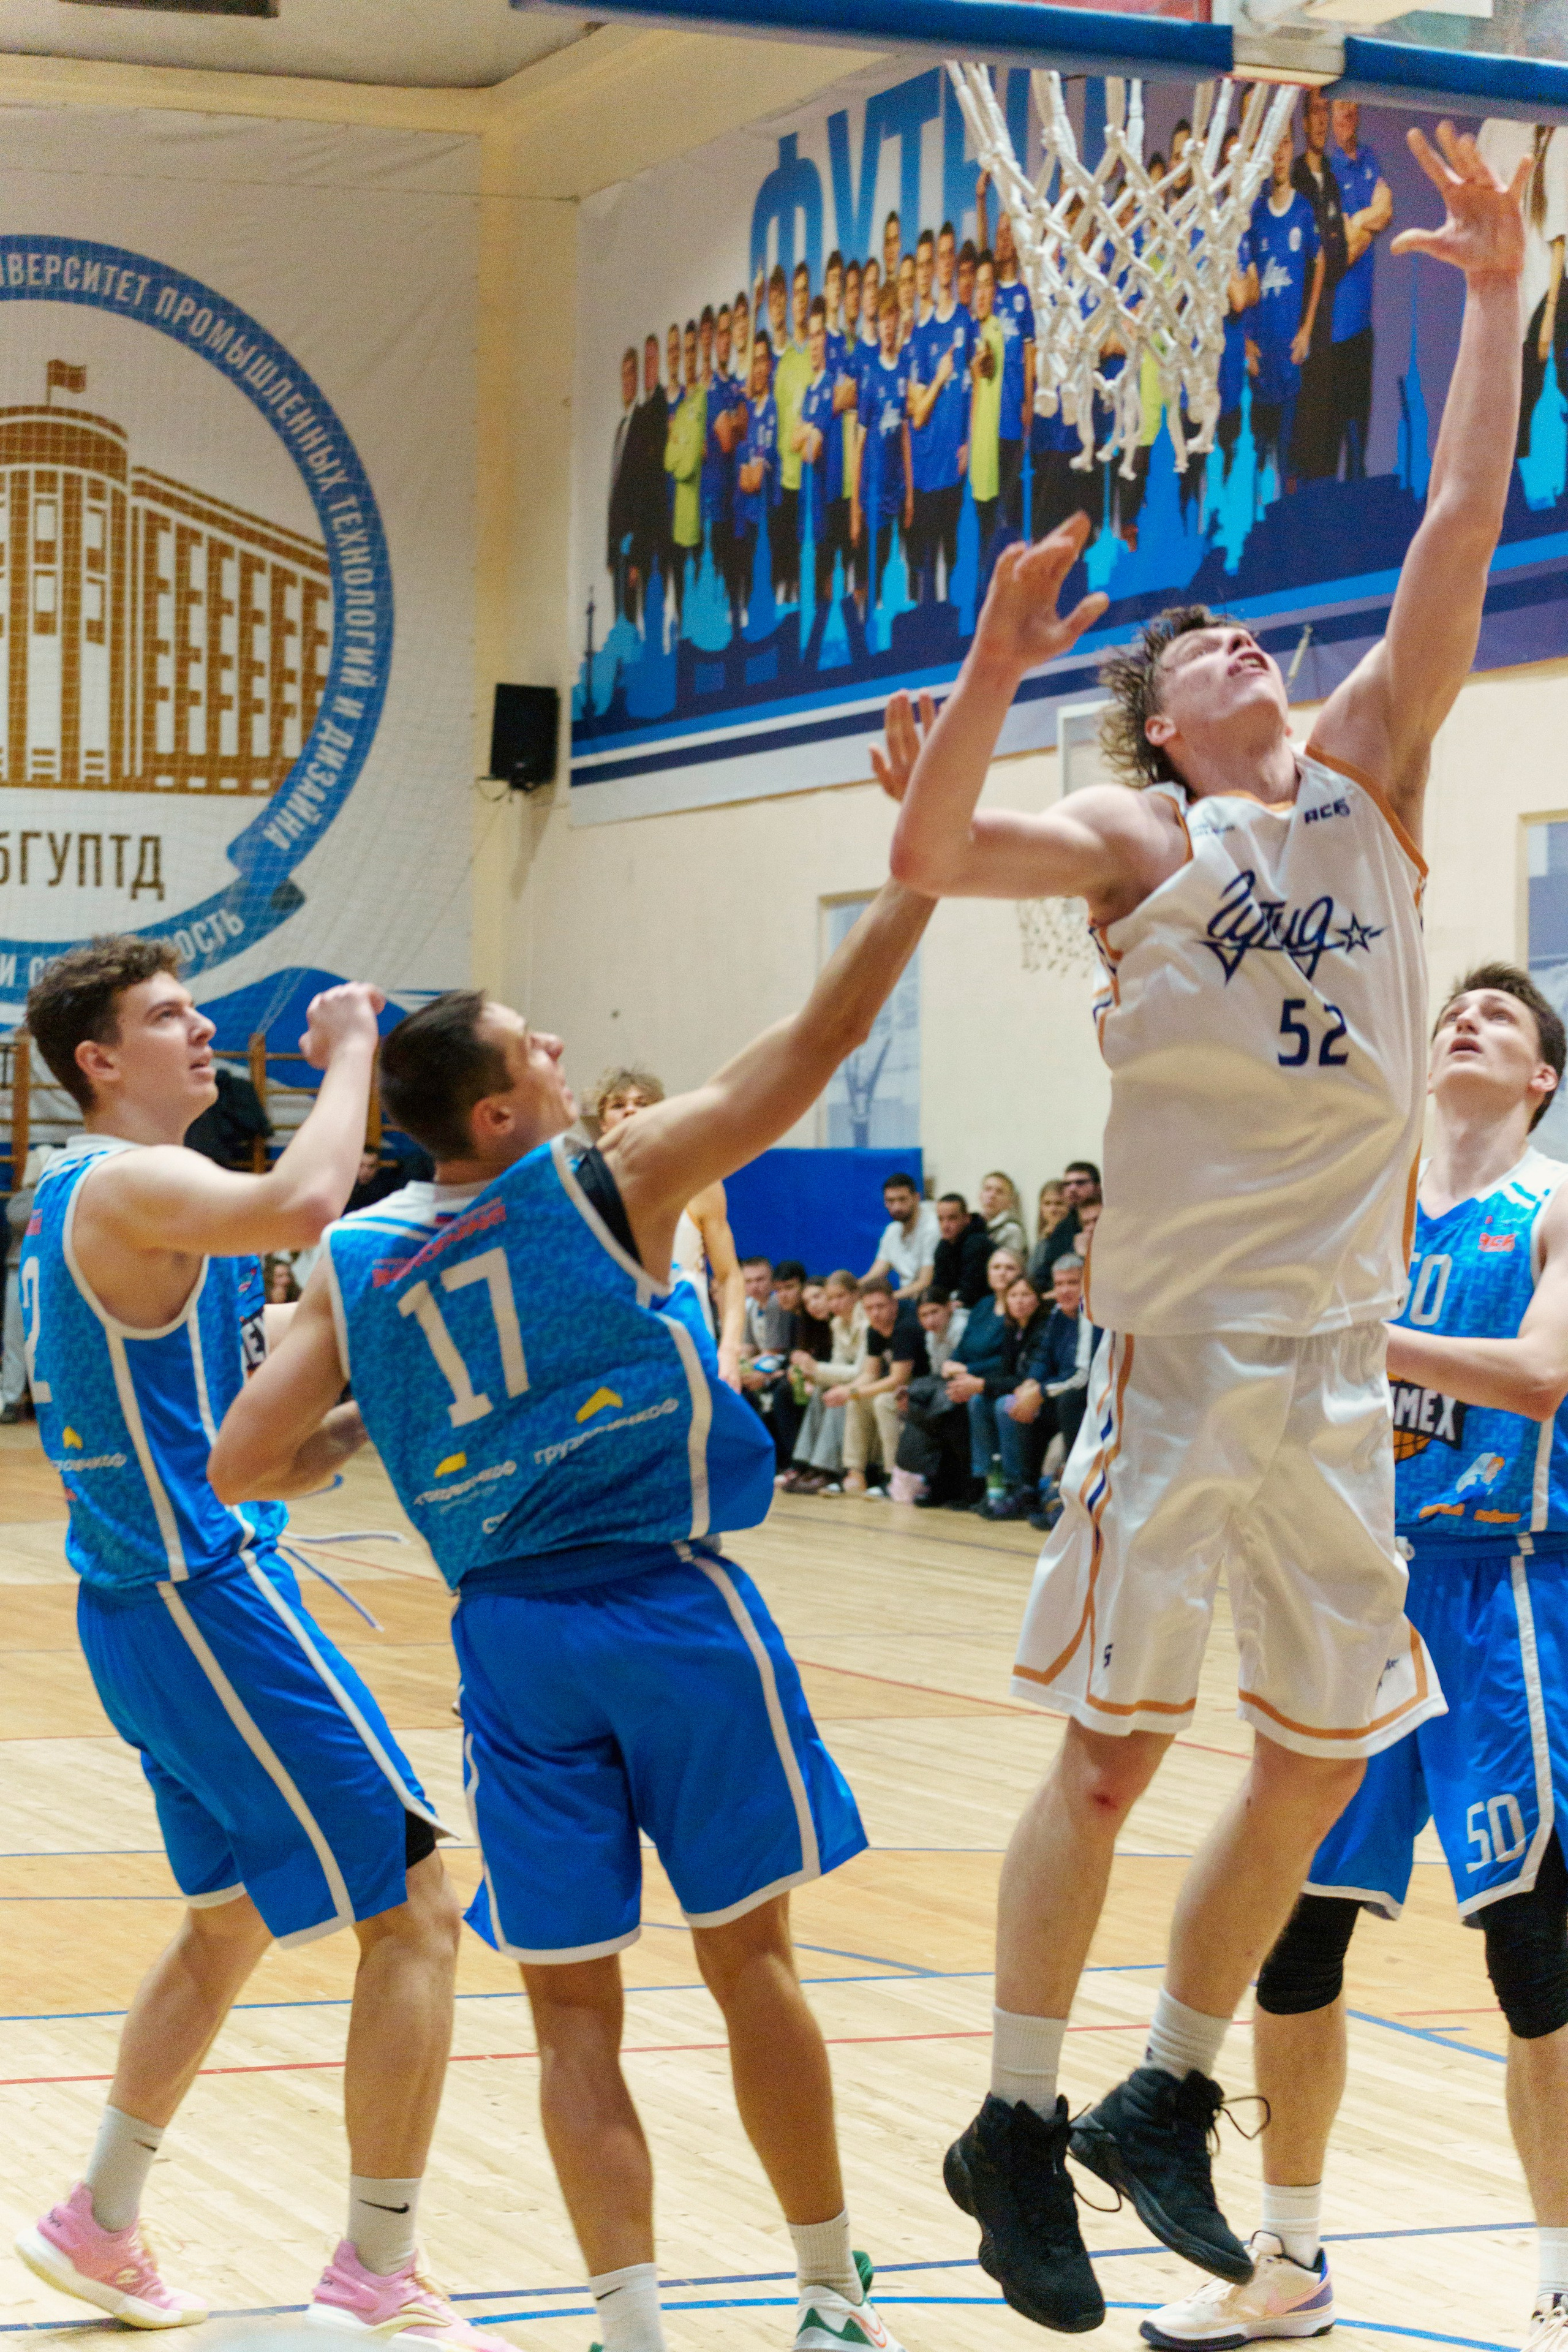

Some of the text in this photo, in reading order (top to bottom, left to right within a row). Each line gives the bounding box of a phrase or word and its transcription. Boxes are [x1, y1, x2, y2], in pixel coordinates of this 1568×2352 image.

[0, 252, 378, 850] ВЕРСИТЕТ ПРОМЫШЛЕННЫХ ТЕХНОЛОГИЙ И ДИЗАЙНА
[1278, 998, 1348, 1066] 52
[1409, 1252, 1452, 1326] 0
[398, 1246, 530, 1428] 17
[1390, 1385, 1457, 1441] MEX
[1466, 1793, 1526, 1874] 50
